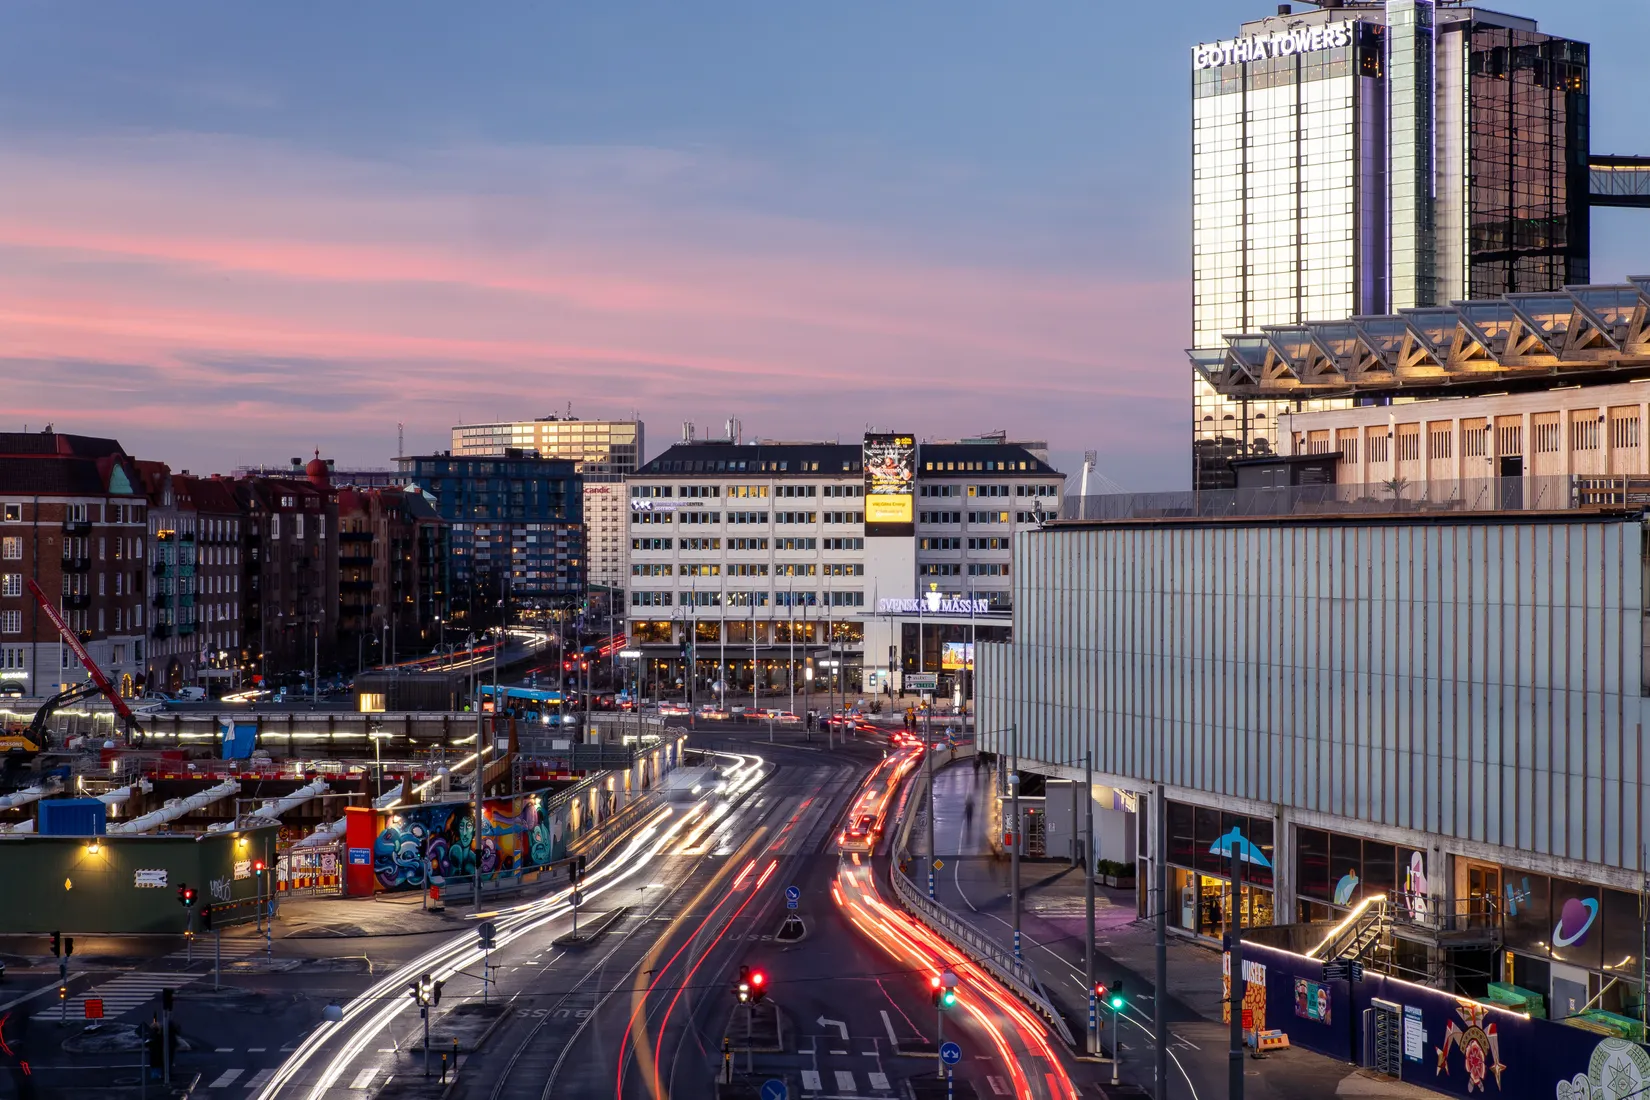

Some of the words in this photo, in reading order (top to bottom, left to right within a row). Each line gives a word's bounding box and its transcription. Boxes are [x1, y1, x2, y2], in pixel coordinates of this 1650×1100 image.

[1195, 39, 1267, 68] GOTHIA
[1271, 28, 1348, 57] TOWERS
[880, 598, 928, 612] SVENSKA
[941, 597, 989, 613] MÄSSAN
